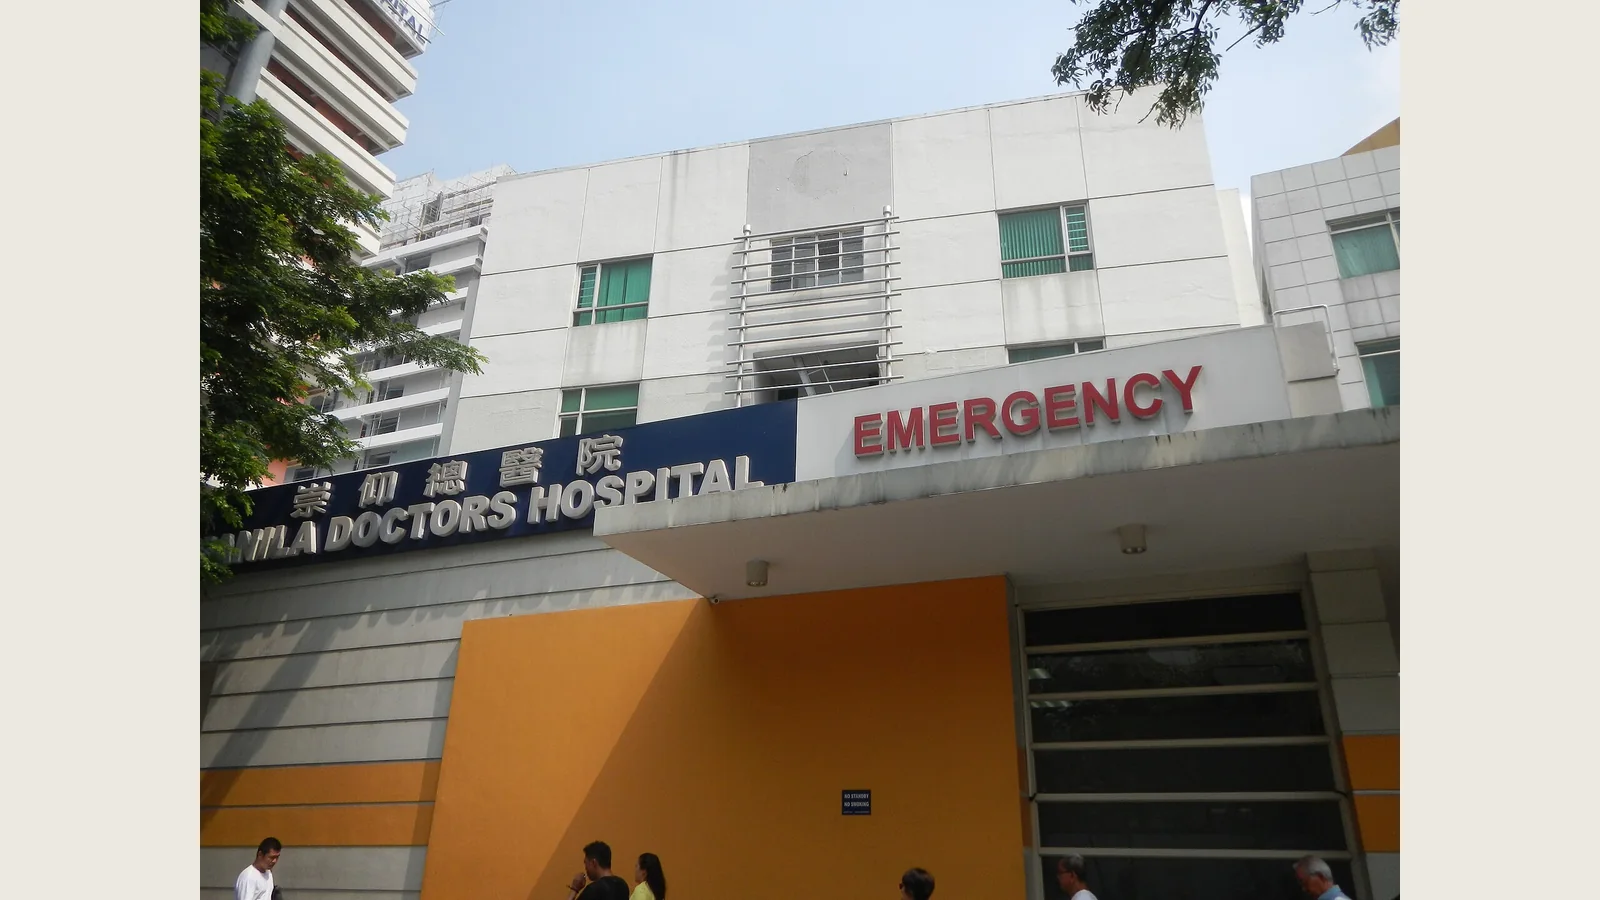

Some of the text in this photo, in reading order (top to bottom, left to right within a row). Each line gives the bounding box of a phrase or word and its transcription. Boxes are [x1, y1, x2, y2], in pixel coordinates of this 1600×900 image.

[853, 365, 1203, 458] EMERGENCY
[203, 455, 765, 563] ANILA DOCTORS HOSPITAL
[290, 434, 624, 518] 崇仰總醫院
